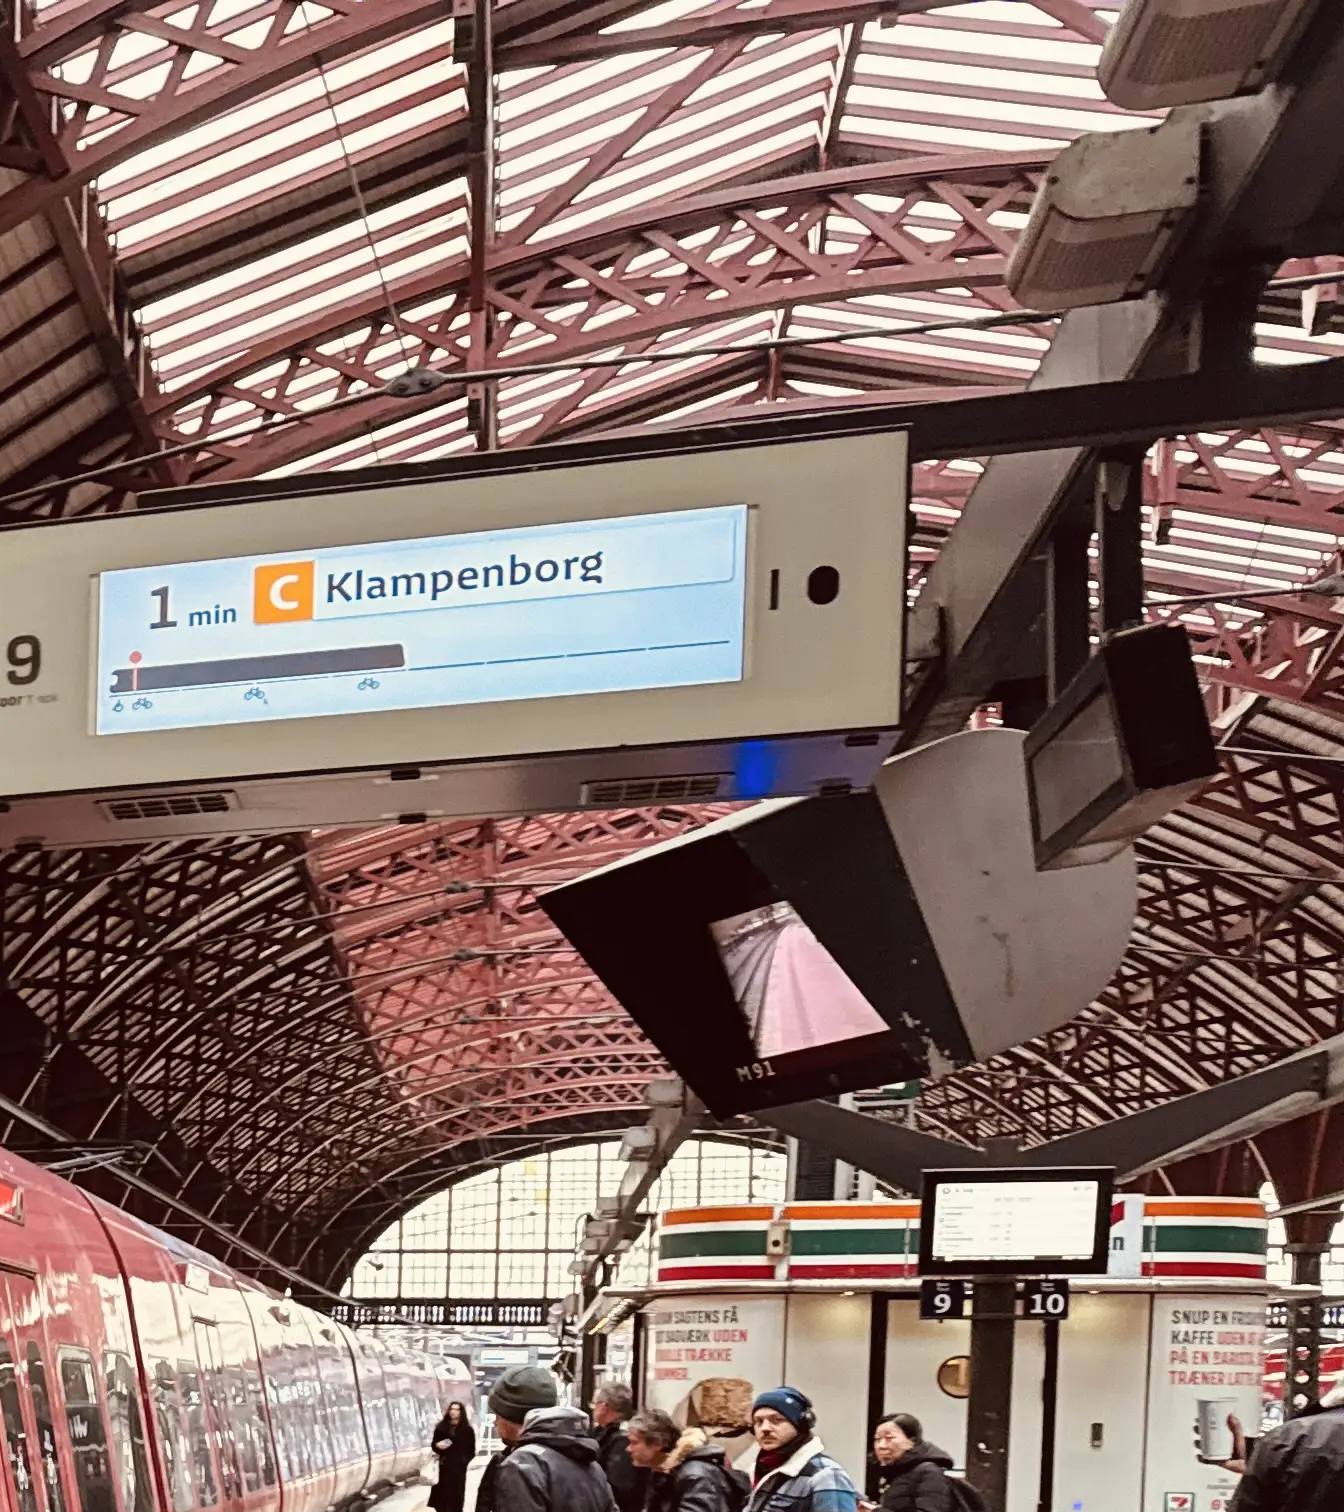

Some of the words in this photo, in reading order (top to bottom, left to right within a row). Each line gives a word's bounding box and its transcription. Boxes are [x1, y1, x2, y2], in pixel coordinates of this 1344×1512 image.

[149, 585, 178, 630] 1
[188, 604, 238, 628] min
[268, 573, 300, 611] C
[325, 550, 605, 604] Klampenborg
[6, 634, 42, 686] 9
[735, 1060, 777, 1083] M91
[723, 1305, 739, 1324] FÅ
[933, 1293, 952, 1315] 9
[1029, 1293, 1065, 1315] 10
[1171, 1309, 1210, 1325] SNUP
[1213, 1310, 1229, 1325] EN
[1170, 1330, 1215, 1345] KAFFE
[1192, 1350, 1210, 1366] EN
